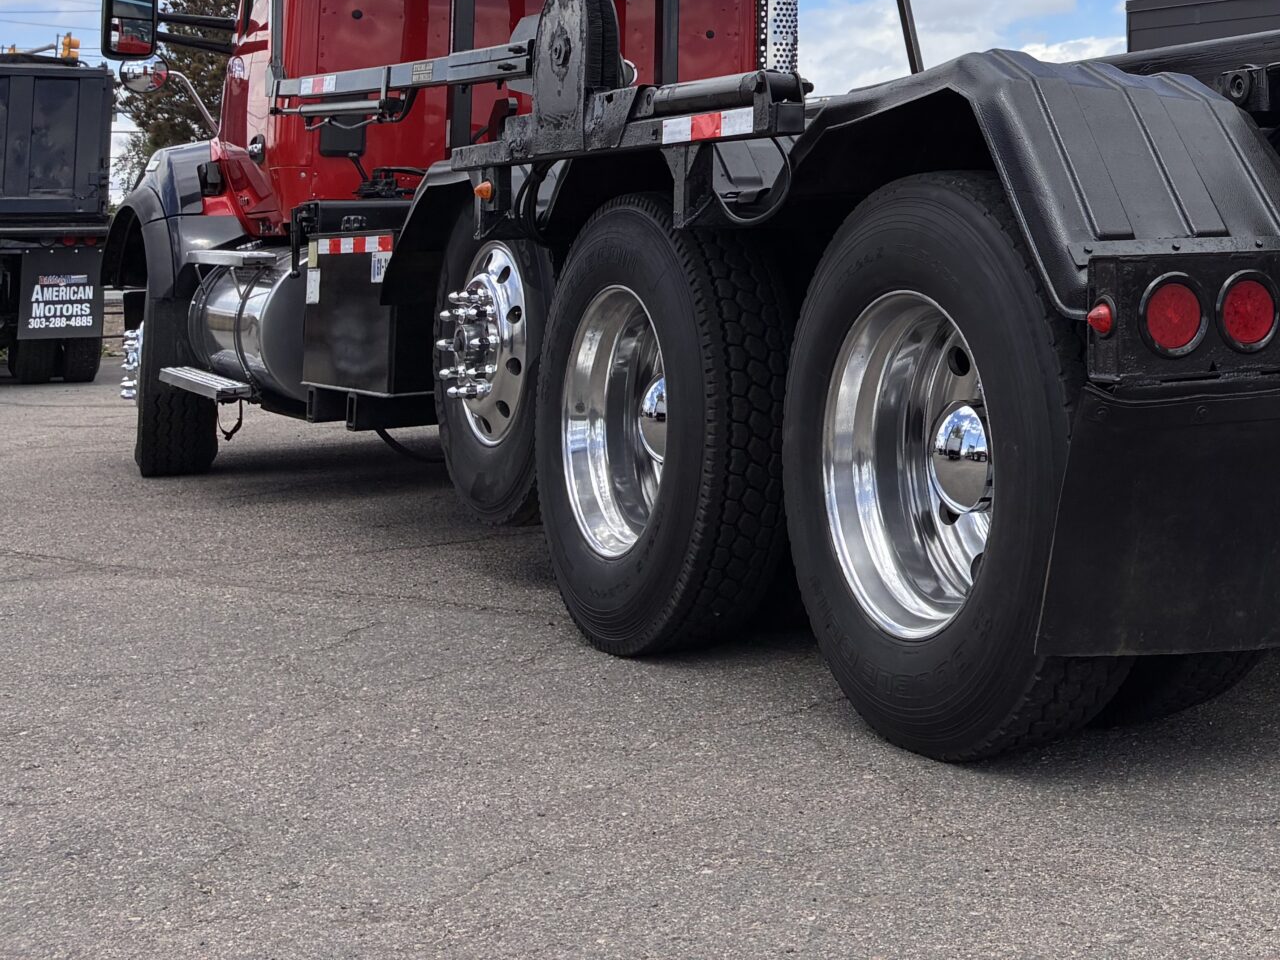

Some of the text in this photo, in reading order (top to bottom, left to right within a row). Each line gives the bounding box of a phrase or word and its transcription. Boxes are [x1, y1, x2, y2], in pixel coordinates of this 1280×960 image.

[31, 285, 93, 301] AMERICAN
[32, 302, 91, 317] MOTORS
[28, 316, 93, 328] 303-288-4885
